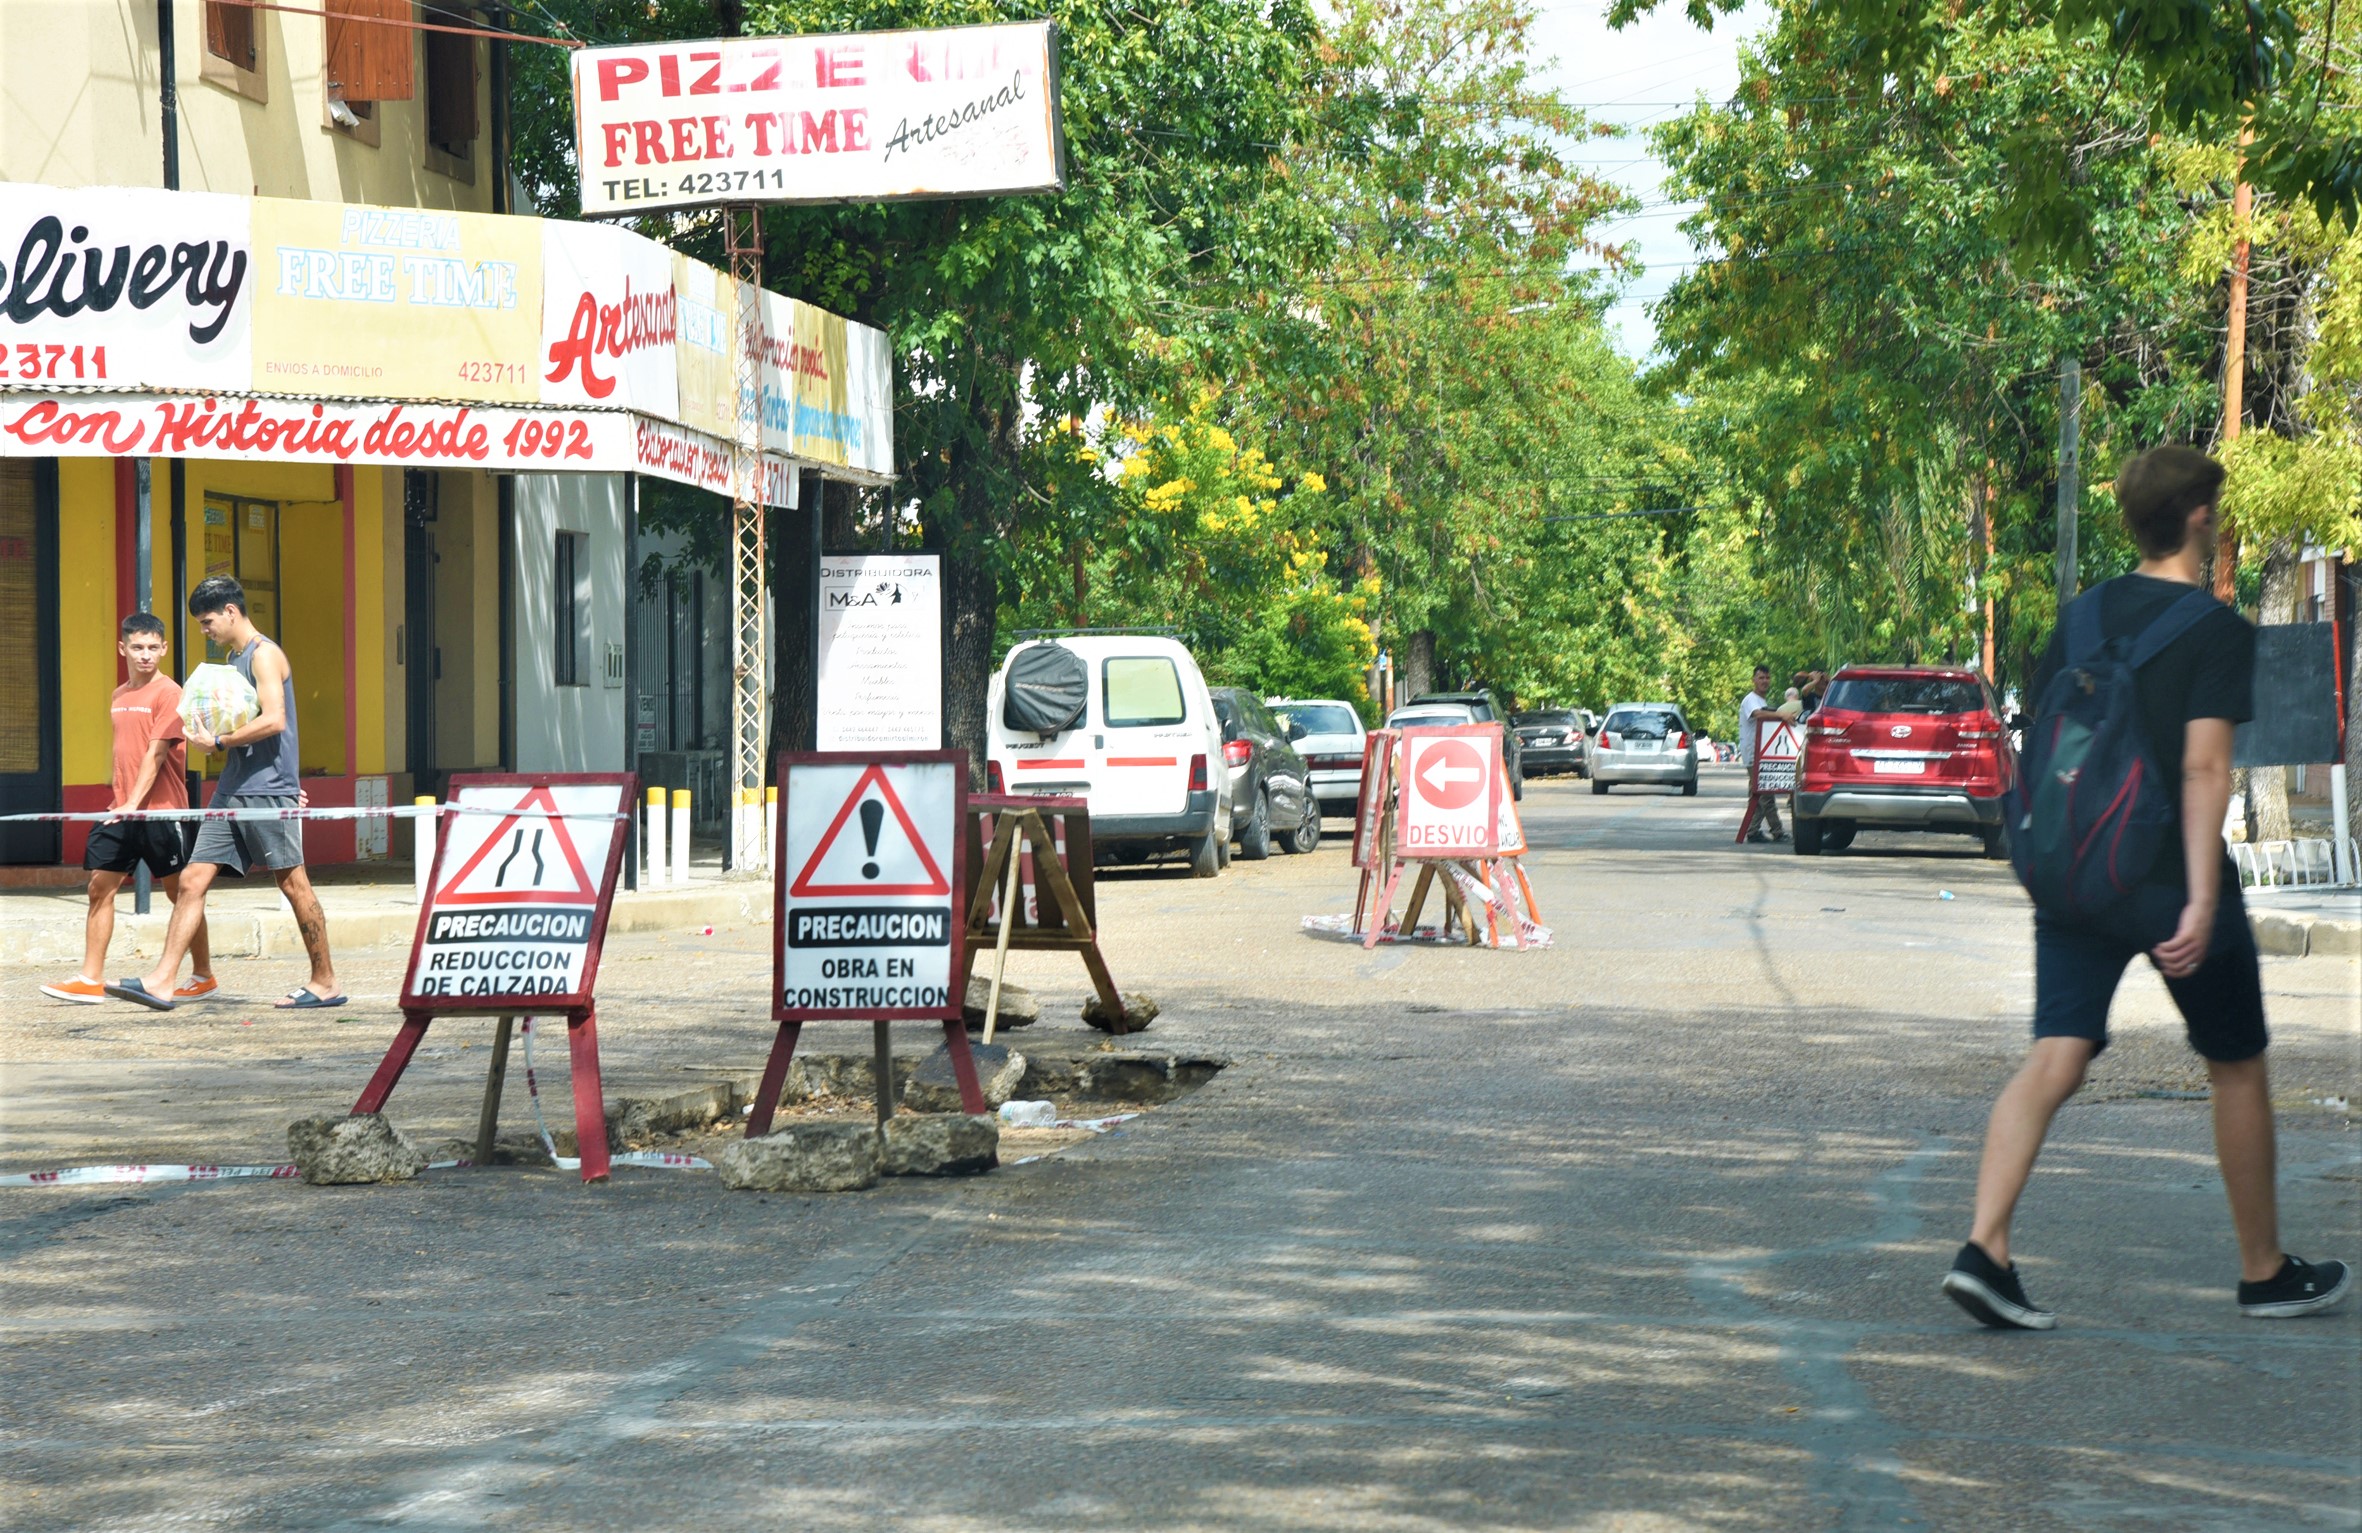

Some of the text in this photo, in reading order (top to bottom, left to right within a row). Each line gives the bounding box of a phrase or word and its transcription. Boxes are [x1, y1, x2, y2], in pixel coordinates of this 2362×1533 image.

[884, 69, 1027, 163] Artesanal
[602, 106, 872, 168] FREE TIME
[603, 169, 784, 201] TEL: 423711
[340, 208, 461, 251] PIZZERIA
[0, 215, 247, 345] livery
[276, 246, 519, 309] FREE TIME
[266, 361, 383, 378] ENVIOS A DOMICILIO
[458, 361, 527, 385] 423711
[4, 397, 594, 461] Con Historia desde 1992
[1409, 824, 1488, 845] DESVIO
[435, 914, 585, 939] PRECAUCION
[798, 913, 943, 941] PRECAUCION
[430, 950, 571, 971] REDUCCION
[821, 958, 914, 978] OBRA EN
[422, 975, 568, 996] DE CALZADA
[784, 986, 950, 1008] CONSTRUCCION
